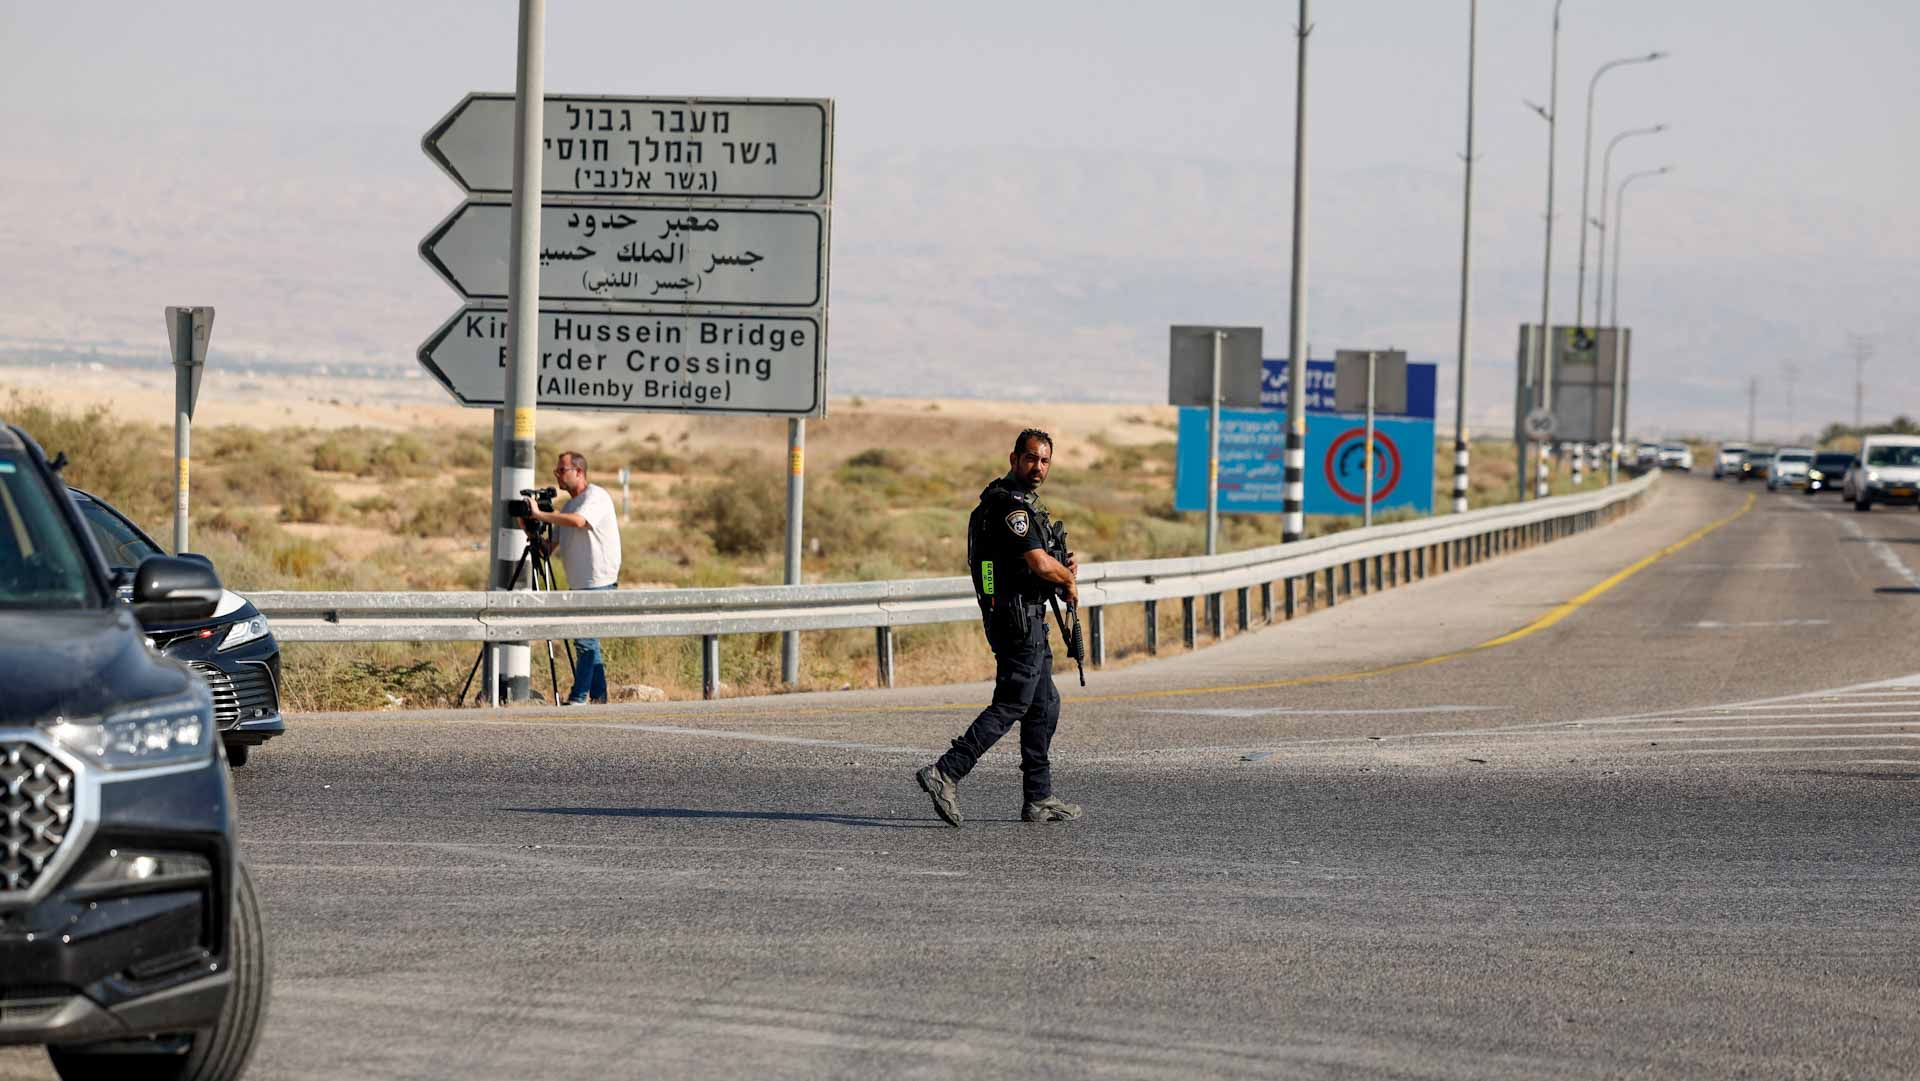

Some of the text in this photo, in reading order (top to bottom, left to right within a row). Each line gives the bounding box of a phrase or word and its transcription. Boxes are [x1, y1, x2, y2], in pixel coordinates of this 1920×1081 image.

[566, 103, 730, 134] מעבר גבול
[543, 136, 777, 166] גשר המלך חוסי
[574, 167, 718, 192] (גשר אלנבי)
[567, 211, 720, 240] معبر حدود
[540, 241, 764, 273] جسر الملك حسي
[582, 271, 702, 296] (جسر اللنبي)
[465, 315, 806, 351] Kin Hussein Bridge
[626, 349, 773, 381] Crossing
[537, 374, 731, 403] (Allenby Bridge)
